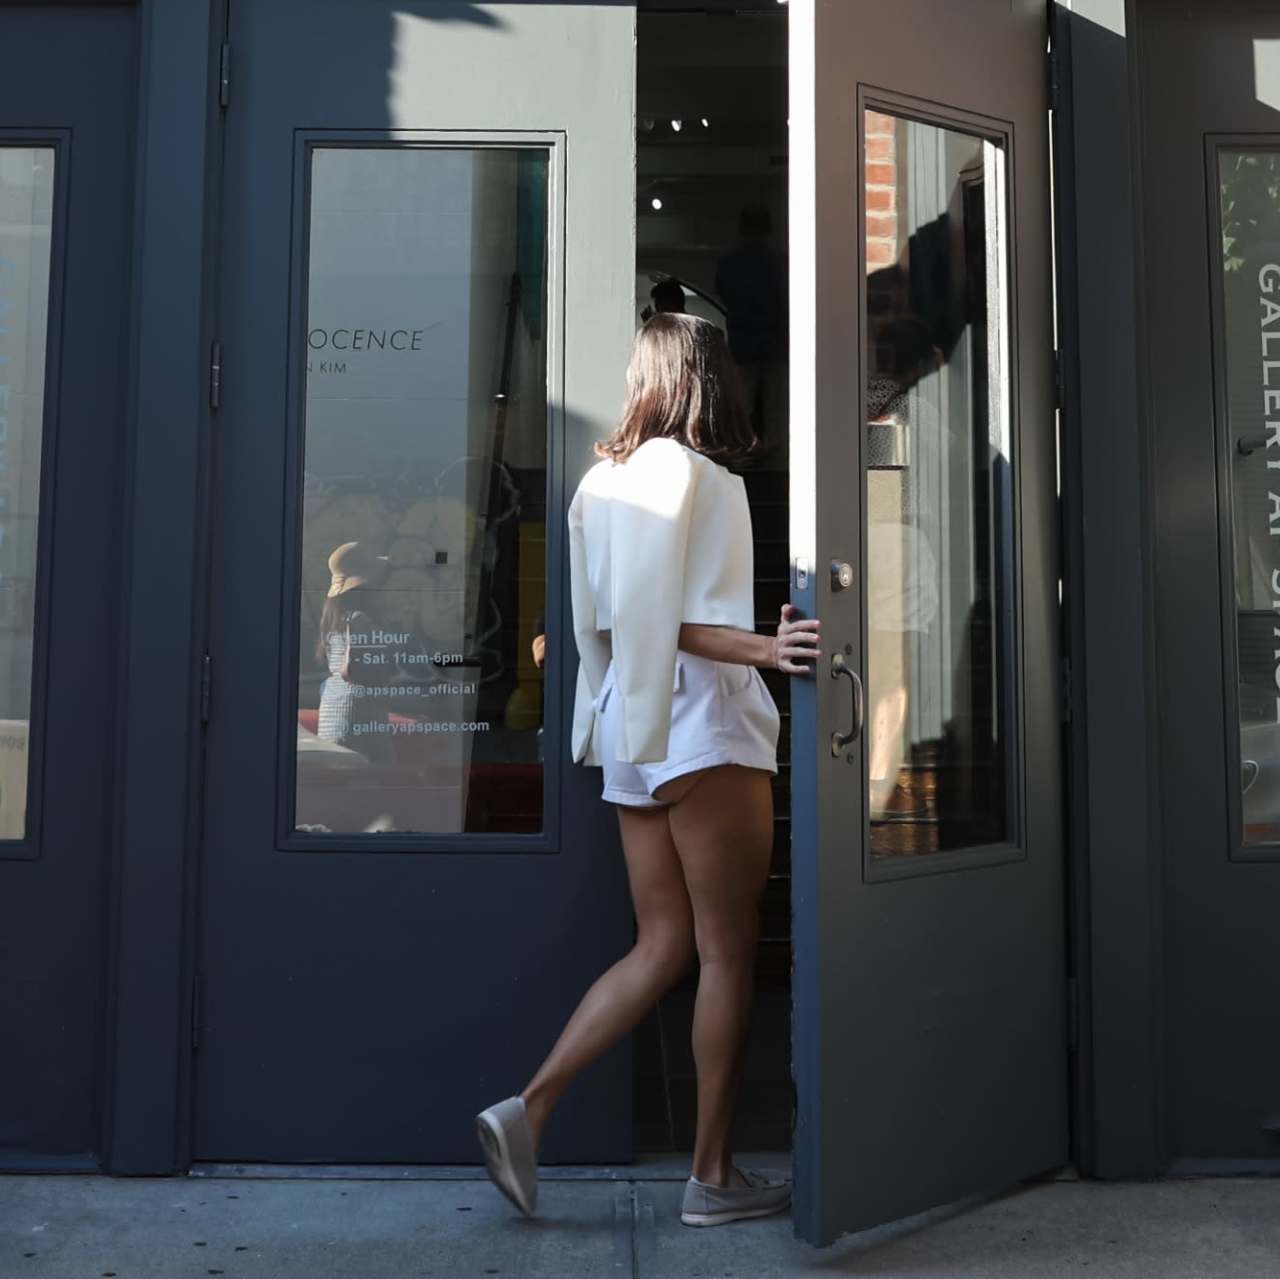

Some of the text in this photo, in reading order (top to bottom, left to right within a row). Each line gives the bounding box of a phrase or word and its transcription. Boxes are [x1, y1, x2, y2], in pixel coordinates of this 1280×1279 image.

[308, 328, 424, 351] OCENCE
[320, 361, 347, 374] KIM
[372, 630, 410, 645] Hour
[395, 652, 464, 665] 11am-6pm
[353, 720, 490, 735] galleryapspace.com
